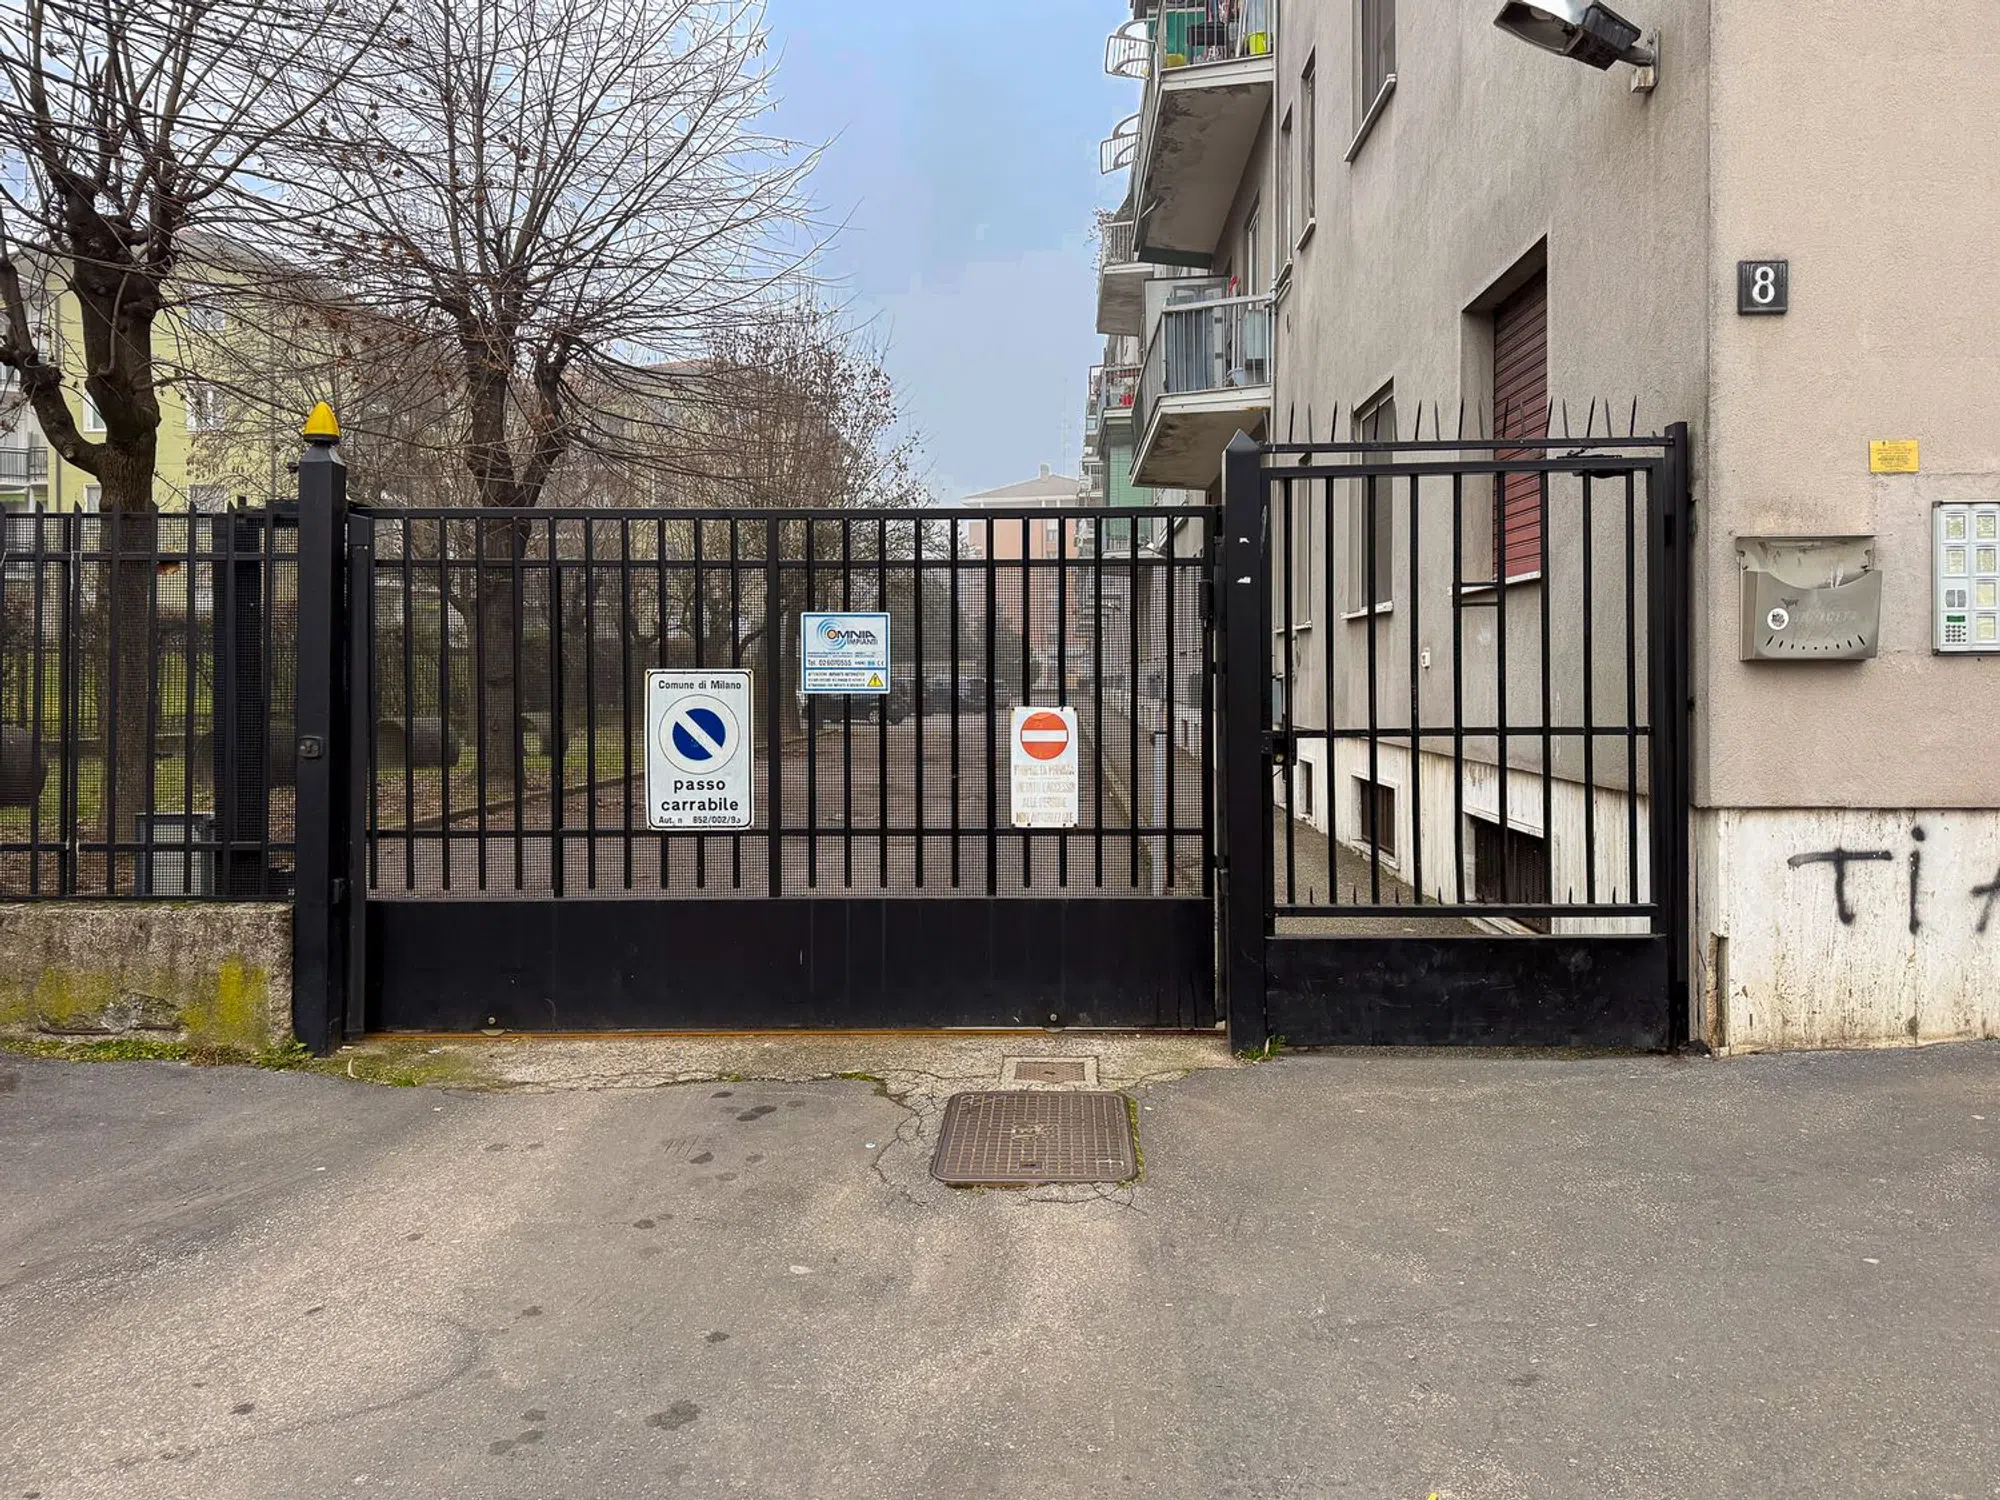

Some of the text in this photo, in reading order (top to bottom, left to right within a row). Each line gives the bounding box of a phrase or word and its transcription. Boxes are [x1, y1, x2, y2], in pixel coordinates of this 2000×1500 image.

[1752, 266, 1775, 304] 8
[827, 629, 876, 639] OMNIA
[658, 680, 742, 690] Comune di Milano
[674, 779, 726, 793] passo
[661, 797, 739, 811] carrabile
[658, 816, 674, 824] Aut.
